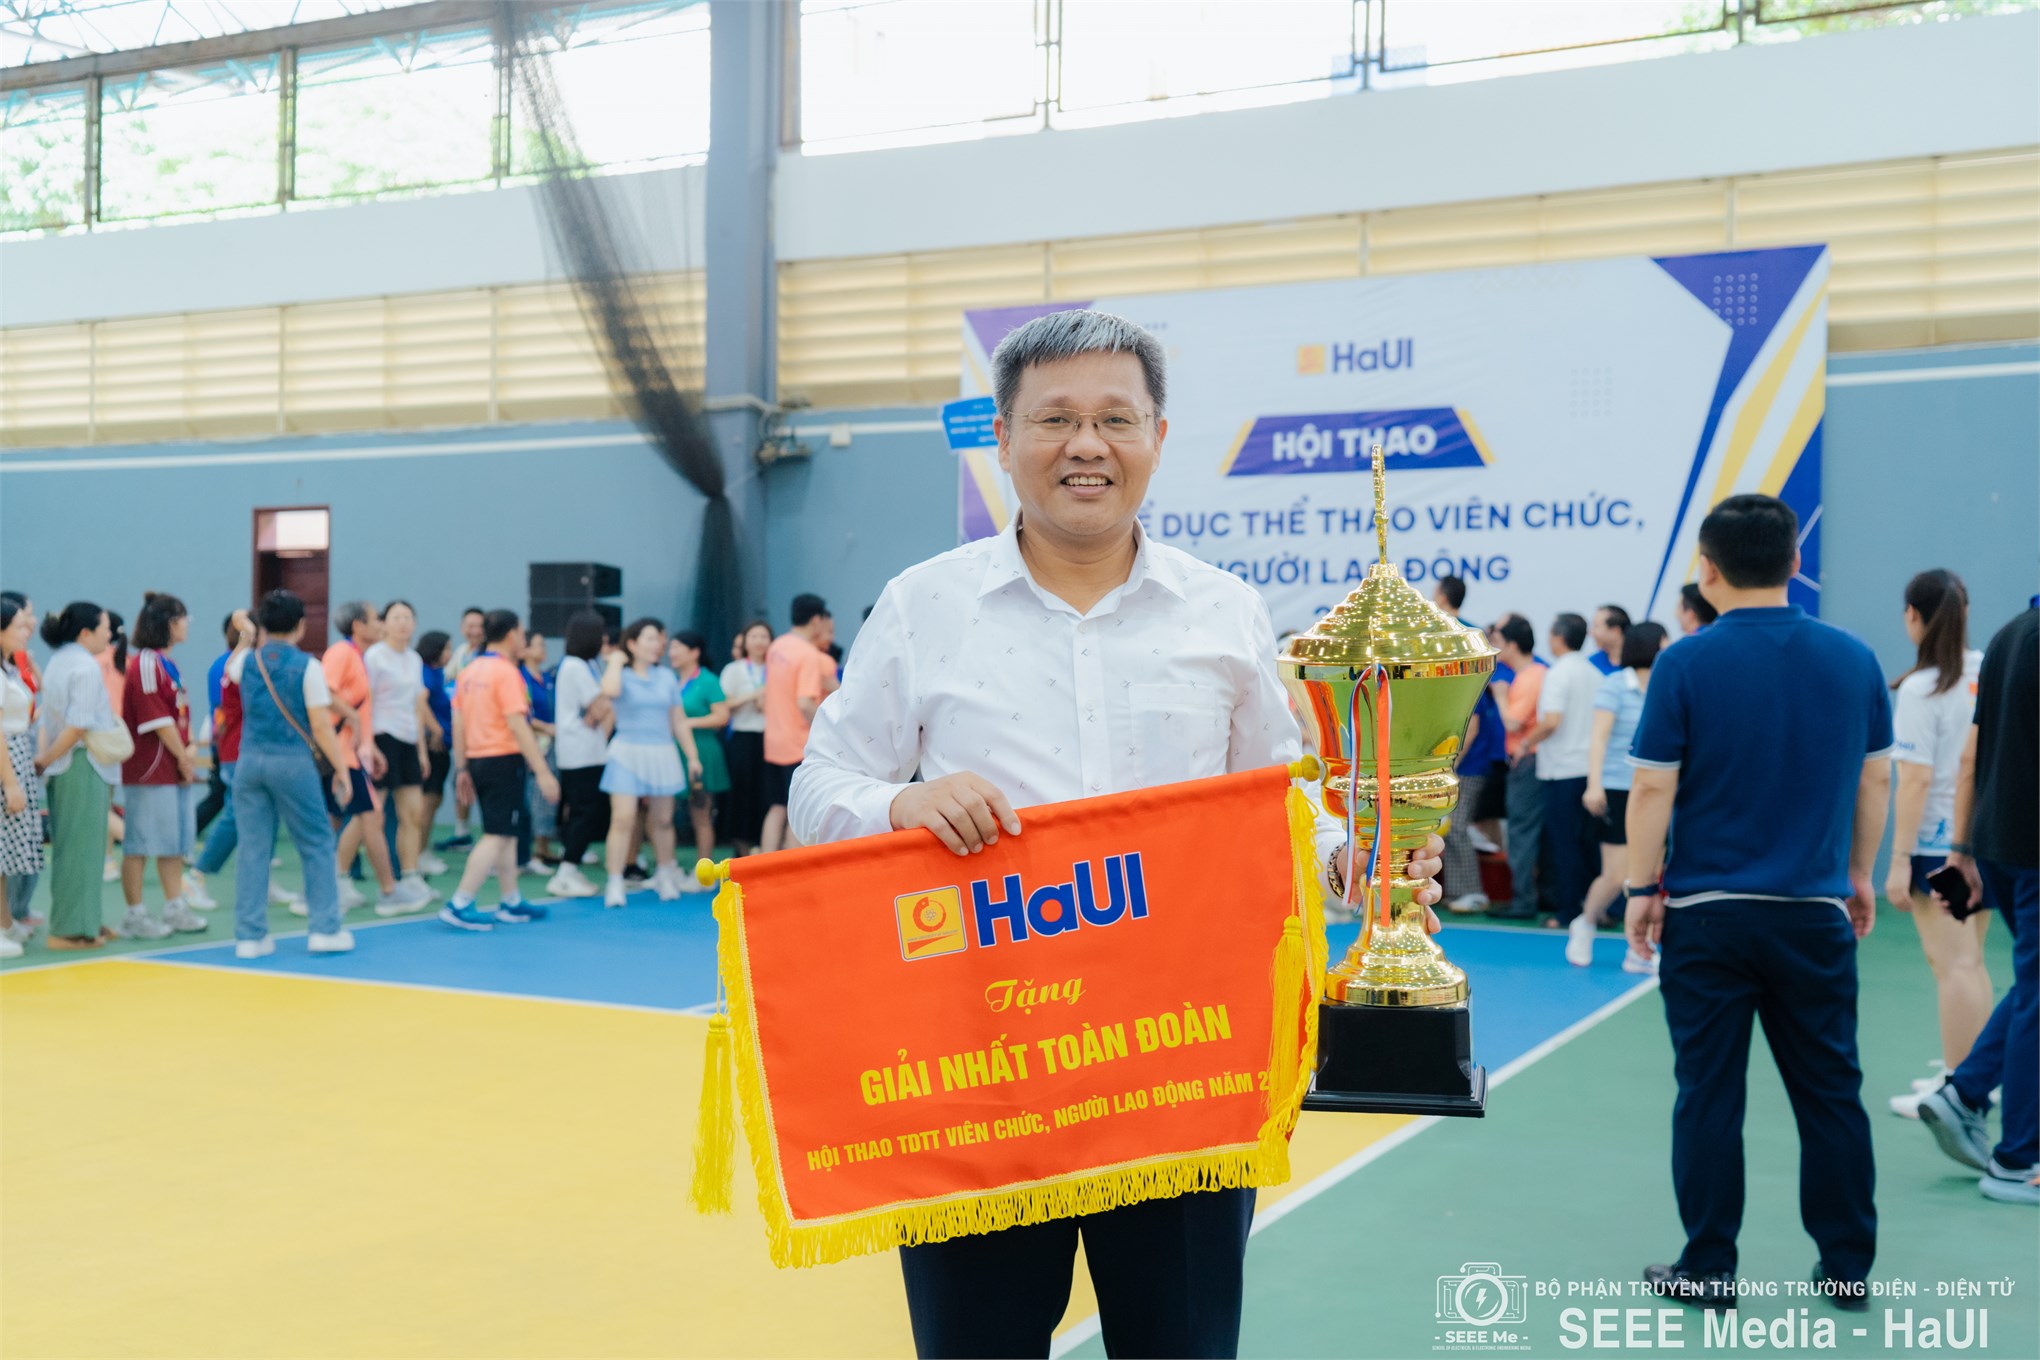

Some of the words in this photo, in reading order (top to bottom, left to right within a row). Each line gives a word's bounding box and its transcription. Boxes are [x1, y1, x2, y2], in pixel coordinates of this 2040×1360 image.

[1332, 338, 1413, 373] HaUI
[1272, 423, 1332, 468] HỘI
[1337, 424, 1437, 458] THAO
[1162, 512, 1230, 546] DỤC
[1241, 495, 1309, 535] THỂ
[1427, 496, 1510, 530] VIÊN
[1524, 491, 1645, 531] CHỨC,
[1322, 558, 1391, 583] LA
[970, 851, 1149, 948] HaUI
[985, 977, 1087, 1015] Tặng
[860, 1049, 932, 1106] GIẢI
[939, 1034, 1028, 1091] NHẤT
[1037, 1023, 1128, 1074] TOÀN
[1136, 1001, 1231, 1054] ĐOÀN
[807, 1145, 840, 1172] HỘI
[844, 1138, 893, 1164] THAO
[897, 1130, 940, 1154] TDTT
[945, 1120, 990, 1147] VIÊN
[994, 1110, 1050, 1140] CHỨC,
[1054, 1095, 1109, 1129] NGƯỜI
[1114, 1090, 1148, 1114] LAO
[1152, 1080, 1205, 1108] ĐỘNG
[1209, 1070, 1254, 1097] NĂM
